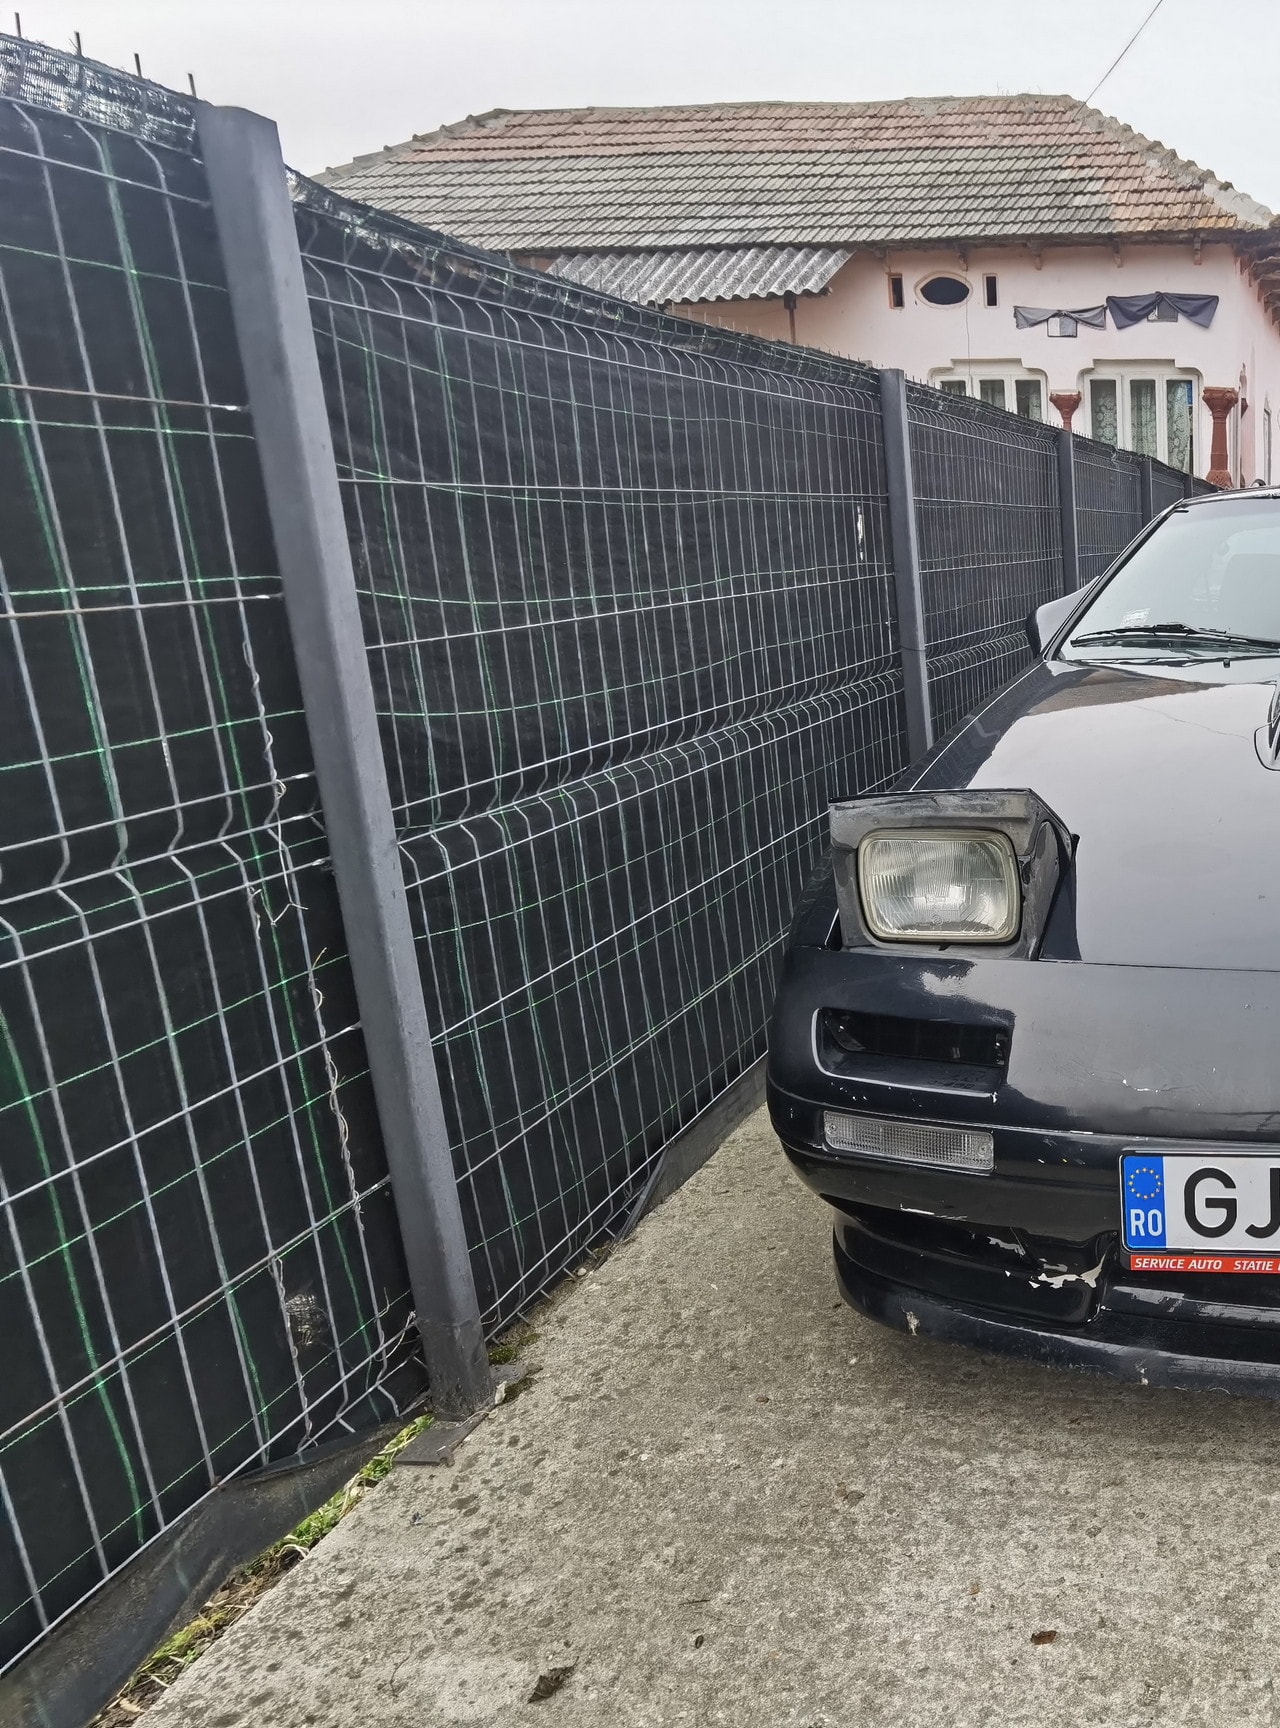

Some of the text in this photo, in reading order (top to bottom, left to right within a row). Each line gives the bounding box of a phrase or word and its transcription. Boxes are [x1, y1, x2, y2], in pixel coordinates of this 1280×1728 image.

[1130, 1208, 1163, 1237] RO
[1135, 1258, 1184, 1269] SERVICE
[1188, 1260, 1222, 1270] AUTO
[1234, 1260, 1273, 1271] STATIE
